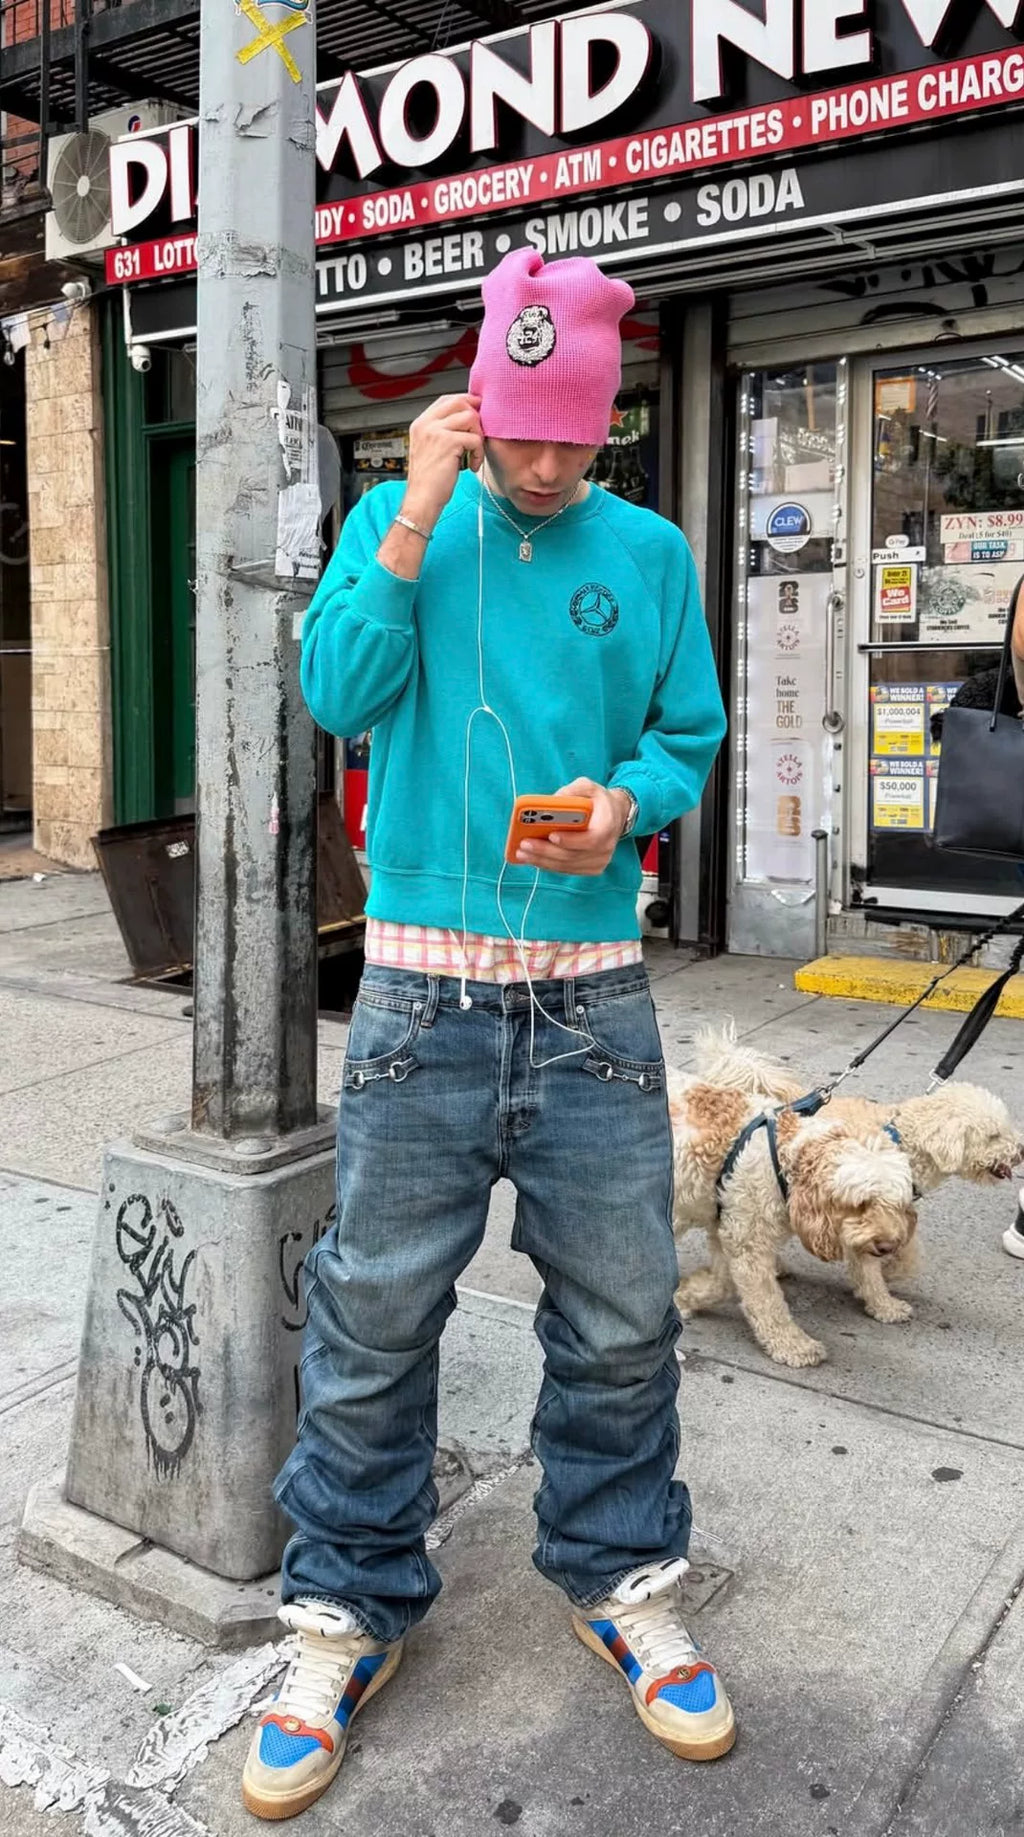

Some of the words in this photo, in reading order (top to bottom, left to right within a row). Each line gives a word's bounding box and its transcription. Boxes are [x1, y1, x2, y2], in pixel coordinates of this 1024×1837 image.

[109, 11, 652, 236] DIMOND
[114, 248, 141, 279] 631
[362, 194, 416, 229] SODA
[434, 166, 534, 214] GROCERY
[554, 148, 601, 190] ATM
[625, 109, 783, 174] CIGARETTES
[811, 79, 909, 135] PHONE
[916, 53, 1024, 112] CHARG
[403, 230, 484, 281] BEER
[525, 198, 650, 255] SMOKE
[697, 168, 805, 227] SODA
[774, 515, 806, 527] CLEW
[987, 513, 1023, 528] $8.99
[989, 541, 1006, 549] TASK
[872, 551, 899, 560] Push
[972, 551, 981, 559] IS
[981, 551, 991, 559] TO
[886, 588, 906, 598] We
[882, 595, 910, 607] Card
[775, 675, 797, 686] Take
[776, 687, 800, 698] home
[889, 687, 901, 695] WE
[889, 694, 925, 702] WINNER!
[776, 700, 796, 714] THE
[775, 714, 803, 729] GOLD
[889, 761, 900, 769] WE
[889, 767, 924, 775] WINNER!
[879, 781, 917, 792] $50,000
